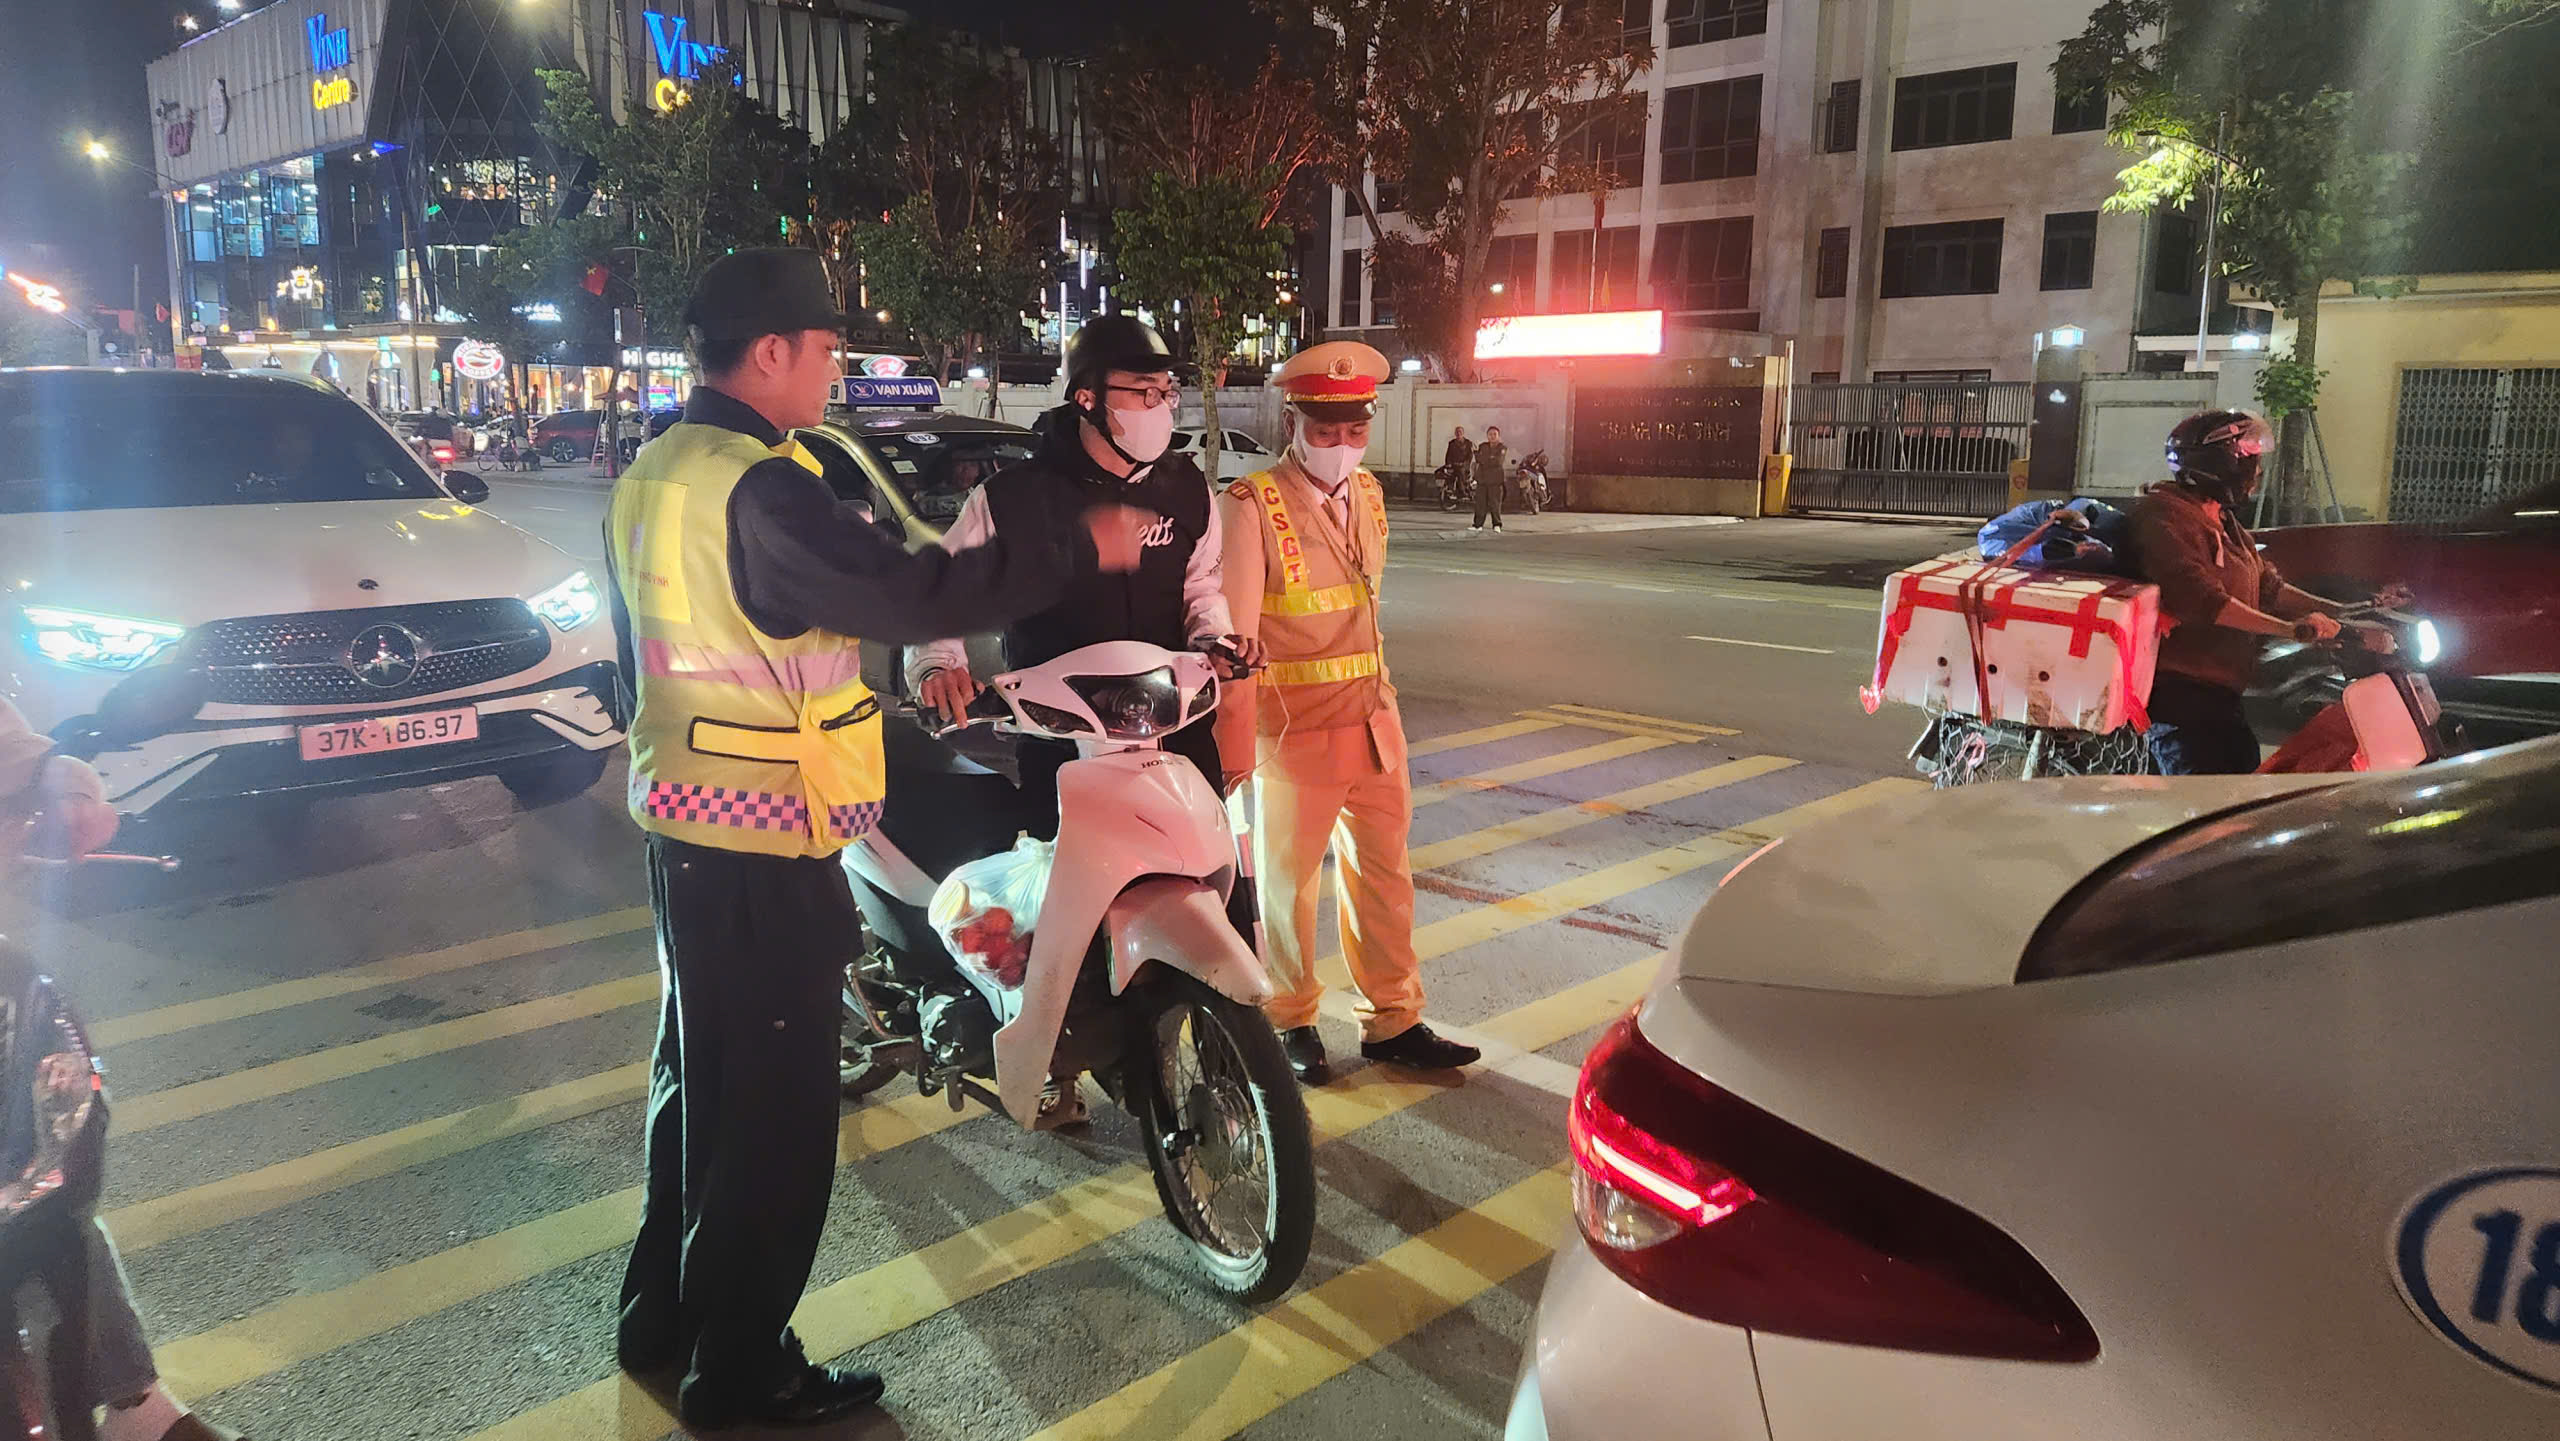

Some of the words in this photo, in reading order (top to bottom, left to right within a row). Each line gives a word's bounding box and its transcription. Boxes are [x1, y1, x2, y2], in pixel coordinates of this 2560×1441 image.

[306, 12, 349, 73] VINH
[622, 349, 688, 367] HIGHL
[875, 384, 900, 398] VẠN
[902, 382, 933, 396] XUÂN
[1264, 486, 1300, 583] CSGT
